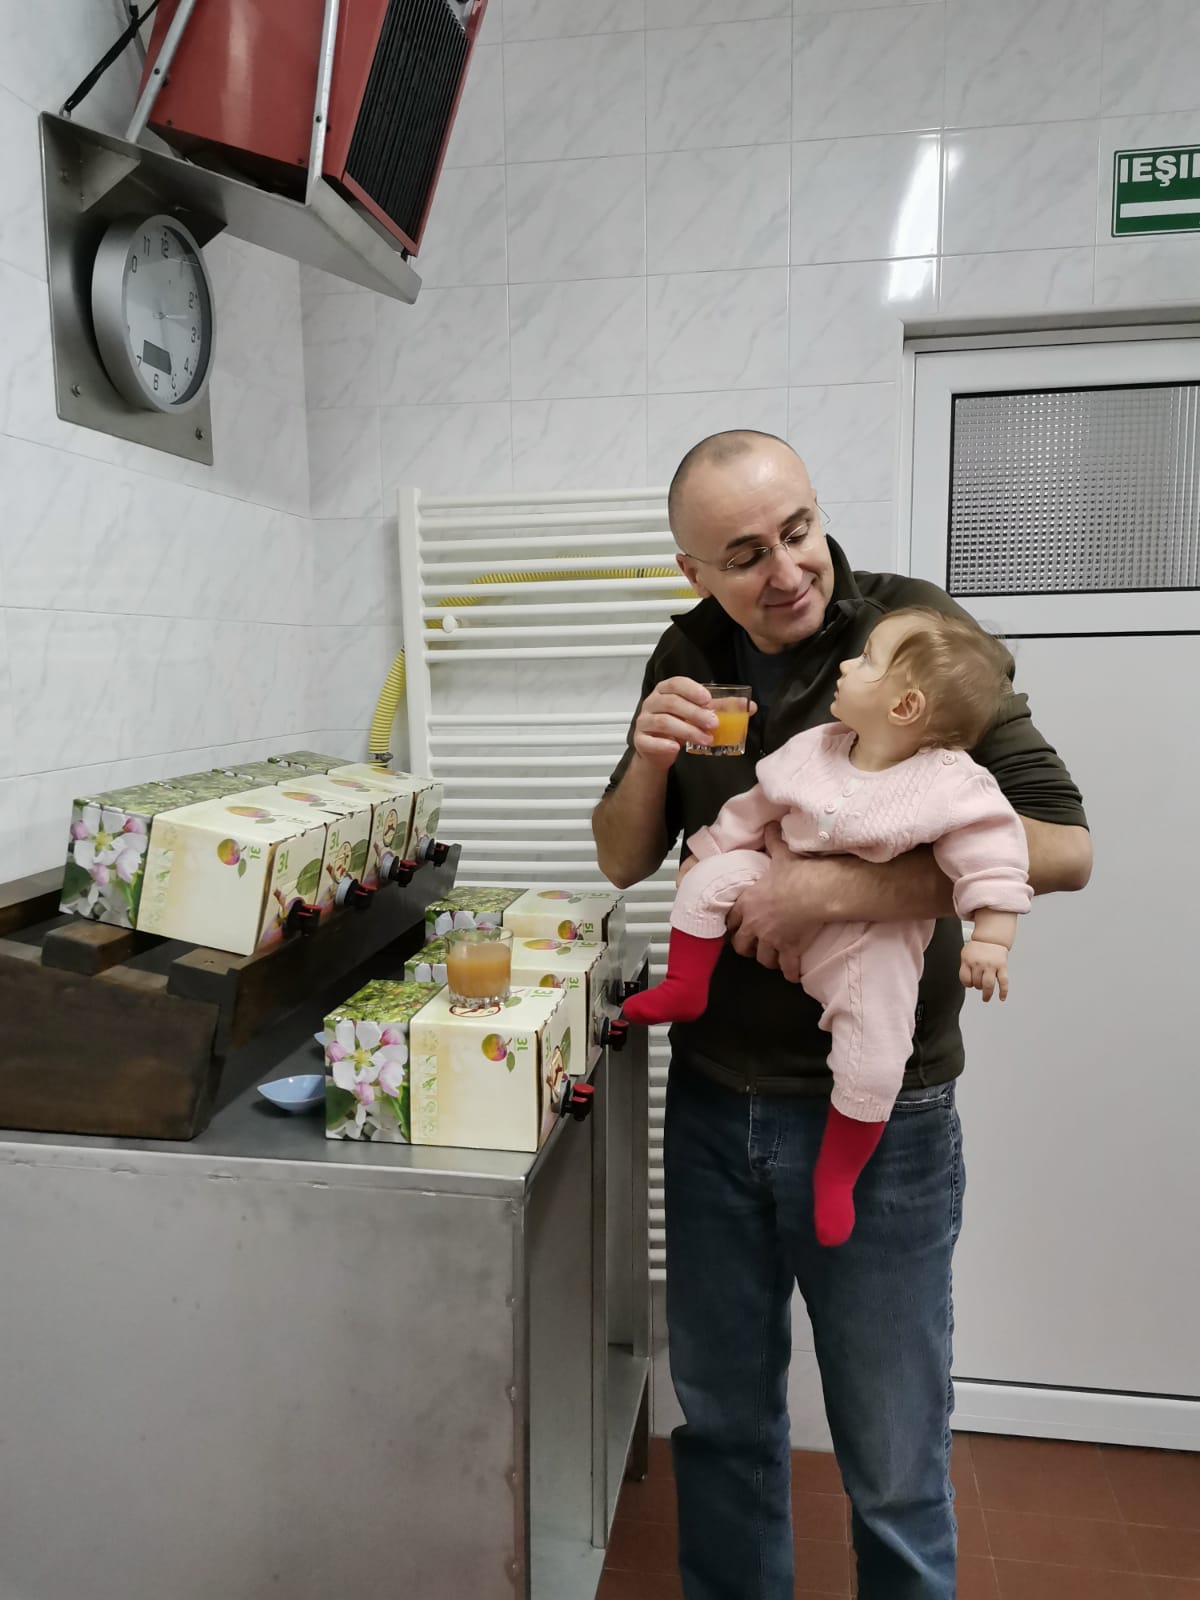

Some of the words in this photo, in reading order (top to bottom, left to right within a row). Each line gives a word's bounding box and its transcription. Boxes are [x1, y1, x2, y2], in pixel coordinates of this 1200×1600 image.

[143, 235, 151, 257] 11
[131, 255, 138, 274] 0
[191, 326, 197, 343] 3
[153, 373, 160, 391] 6
